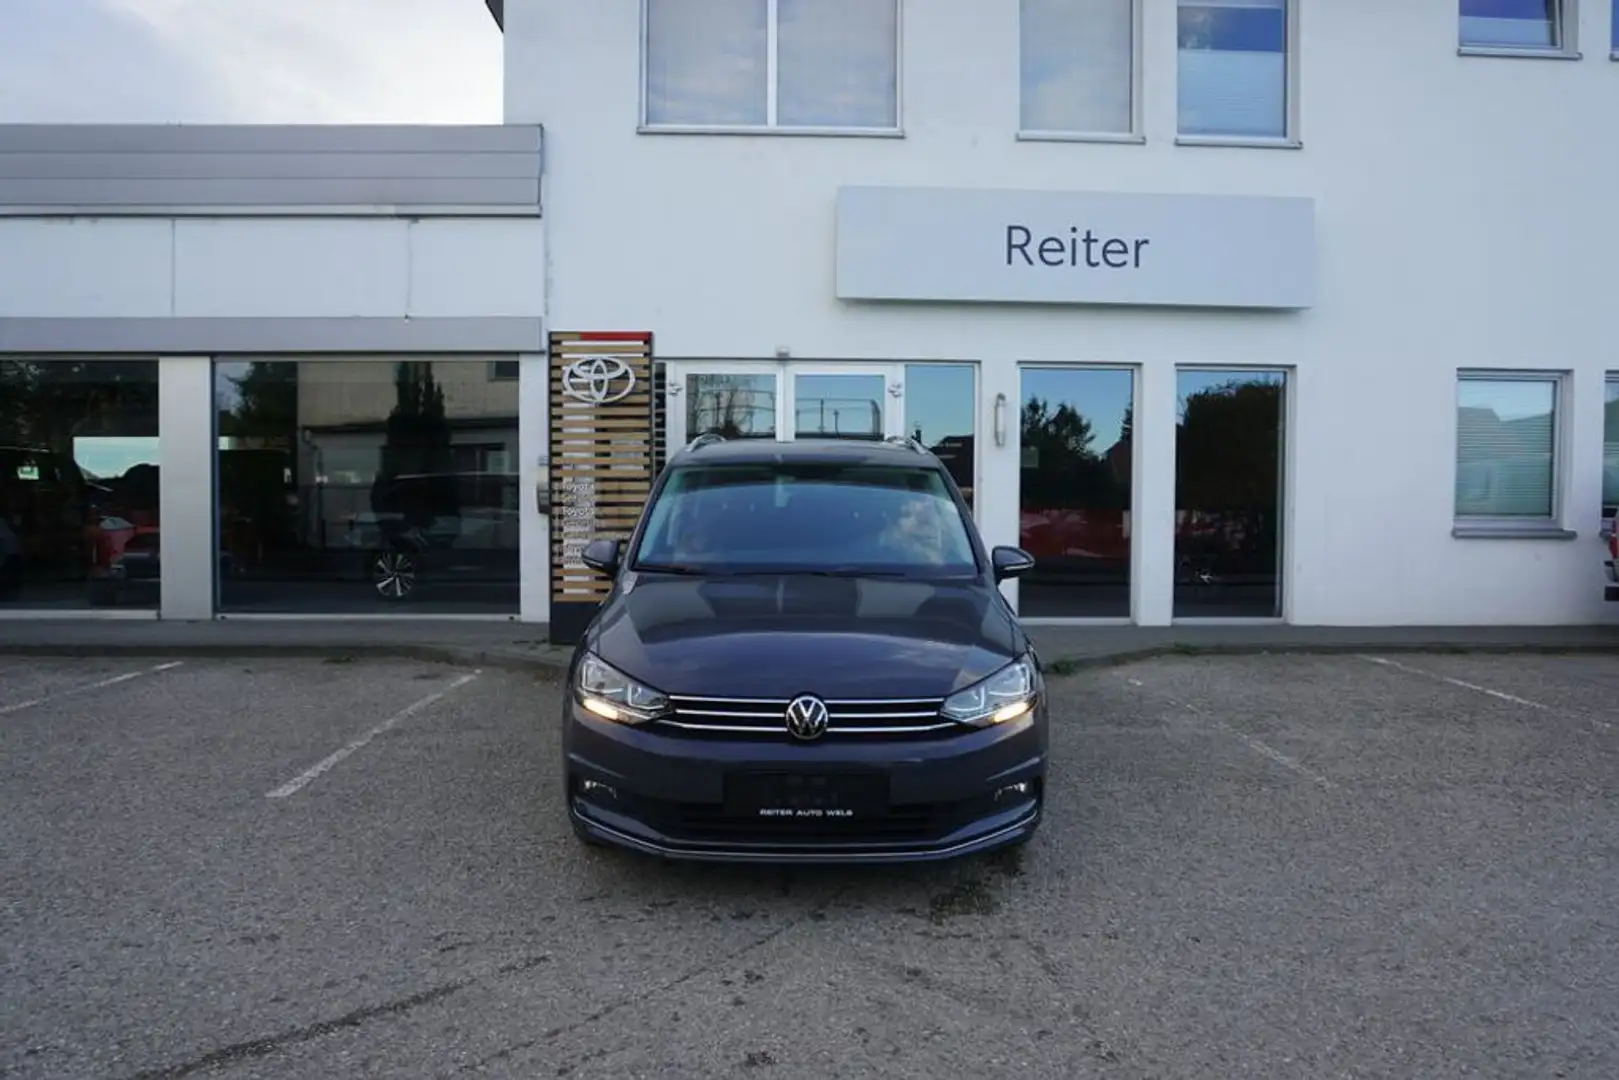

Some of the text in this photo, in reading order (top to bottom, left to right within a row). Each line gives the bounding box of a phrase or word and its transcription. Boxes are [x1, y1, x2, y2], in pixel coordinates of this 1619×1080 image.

[1006, 225, 1150, 268] Reiter
[759, 808, 793, 816] REITER
[796, 808, 823, 816] AUTO
